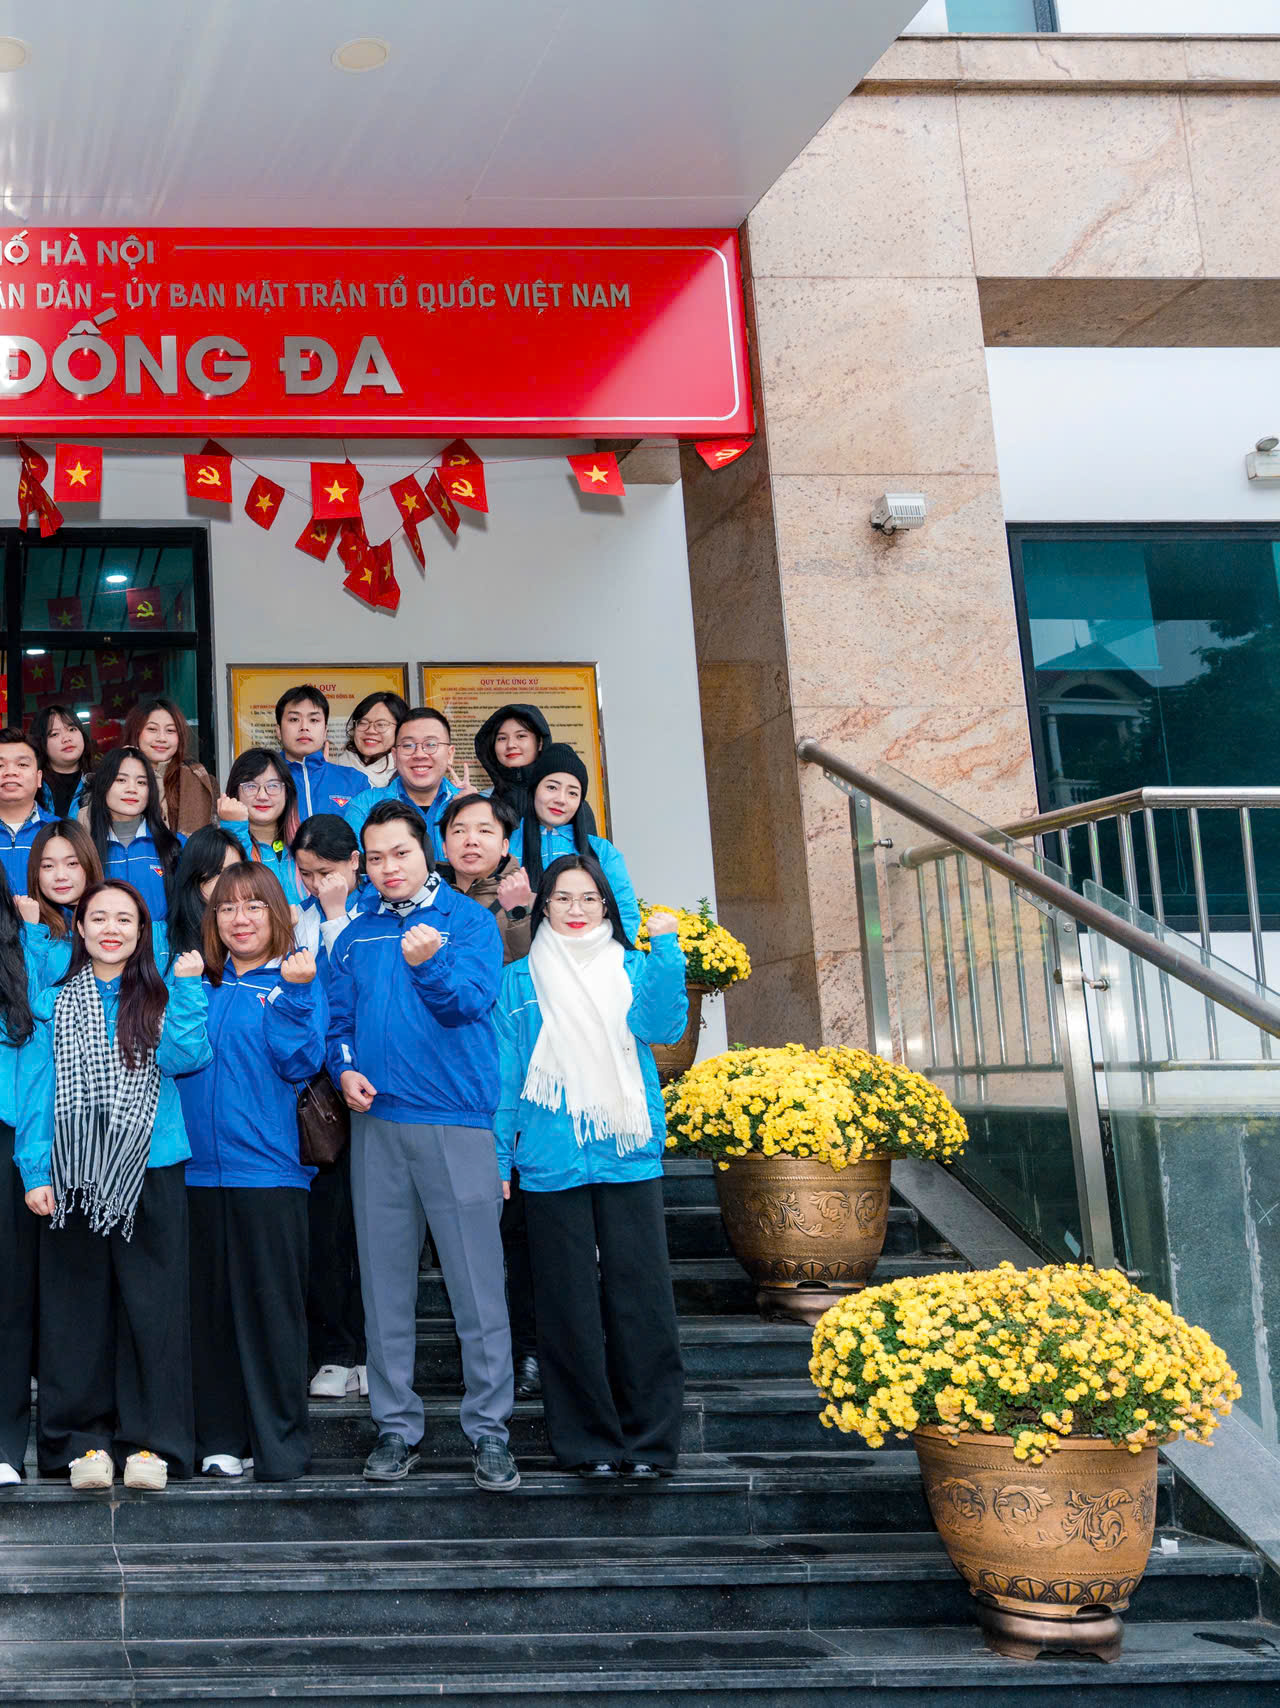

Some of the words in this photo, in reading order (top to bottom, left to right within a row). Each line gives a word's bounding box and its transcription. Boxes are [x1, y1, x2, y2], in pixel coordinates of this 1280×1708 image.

[40, 233, 86, 266] HÀ
[97, 235, 154, 269] NỘI
[36, 279, 92, 309] DÂN
[126, 277, 161, 308] ỦY
[170, 283, 224, 308] BAN
[236, 280, 288, 312] MẶT
[295, 280, 365, 312] TRẬN
[374, 275, 407, 308] TỔ
[418, 276, 495, 312] QUỐC
[504, 280, 562, 314] VIỆT
[573, 283, 631, 308] NAM
[279, 335, 404, 396] ĐA
